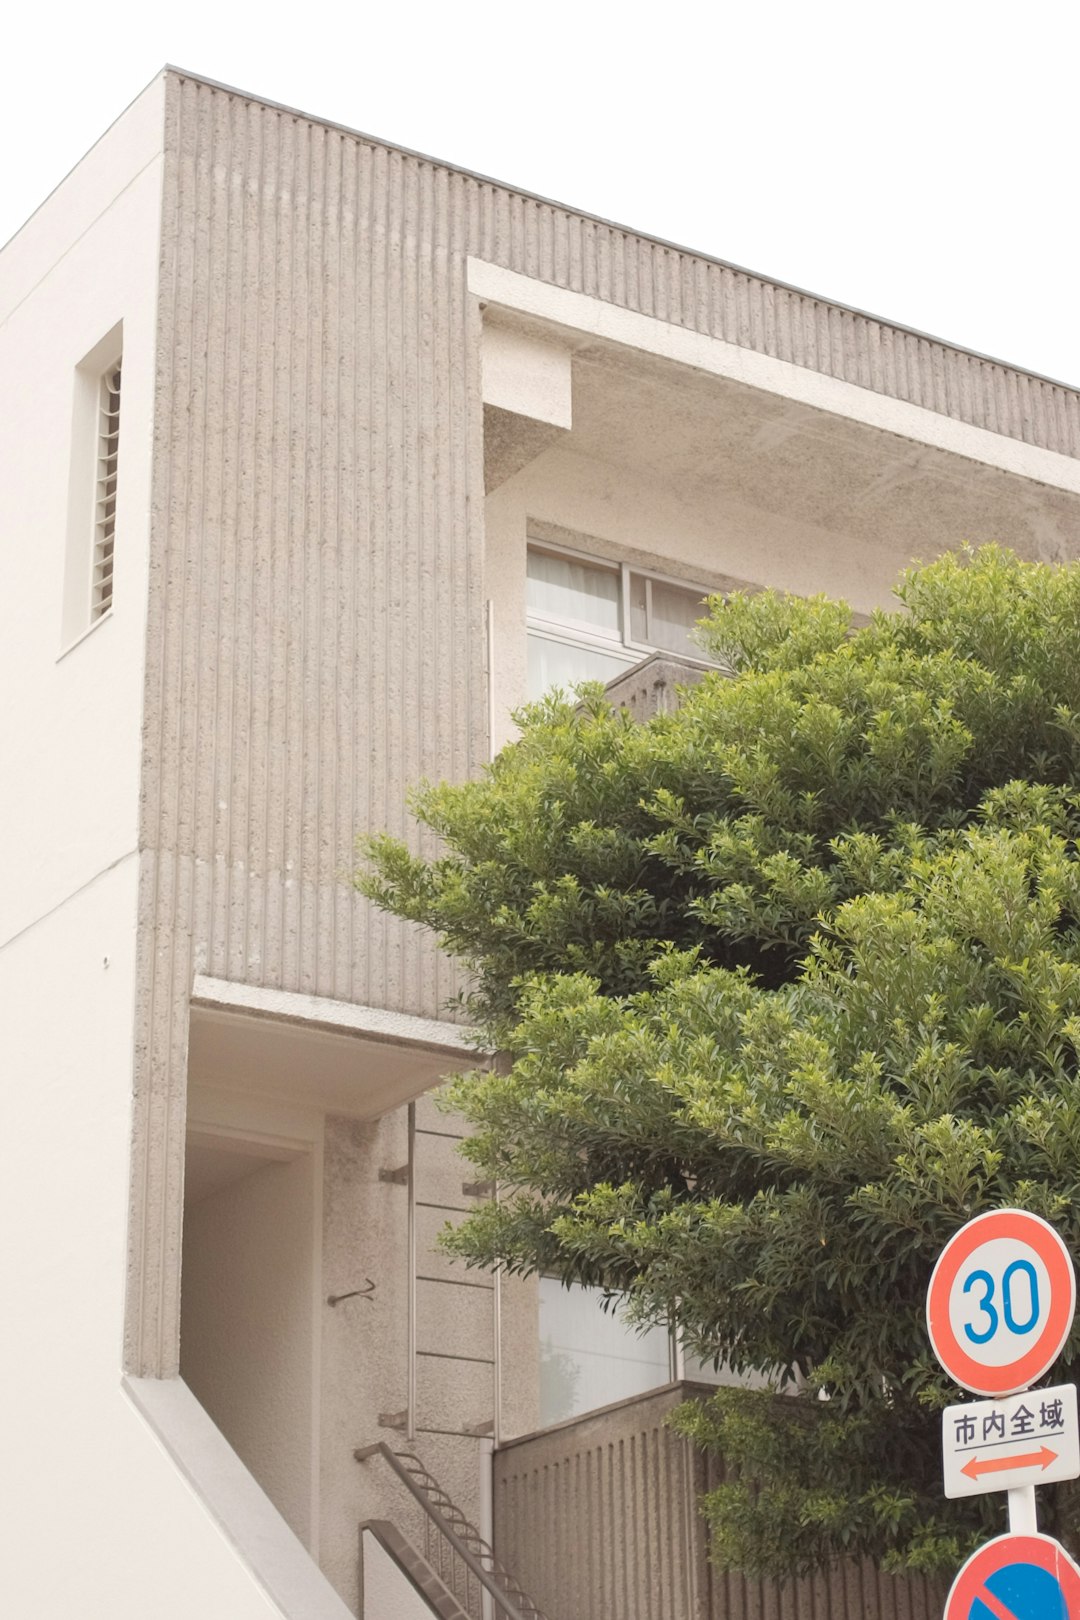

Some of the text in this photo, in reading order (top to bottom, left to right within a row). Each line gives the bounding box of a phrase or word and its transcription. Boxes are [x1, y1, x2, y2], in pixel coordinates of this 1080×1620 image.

[963, 1259, 1039, 1345] 30
[953, 1398, 1065, 1444] 市内全域
